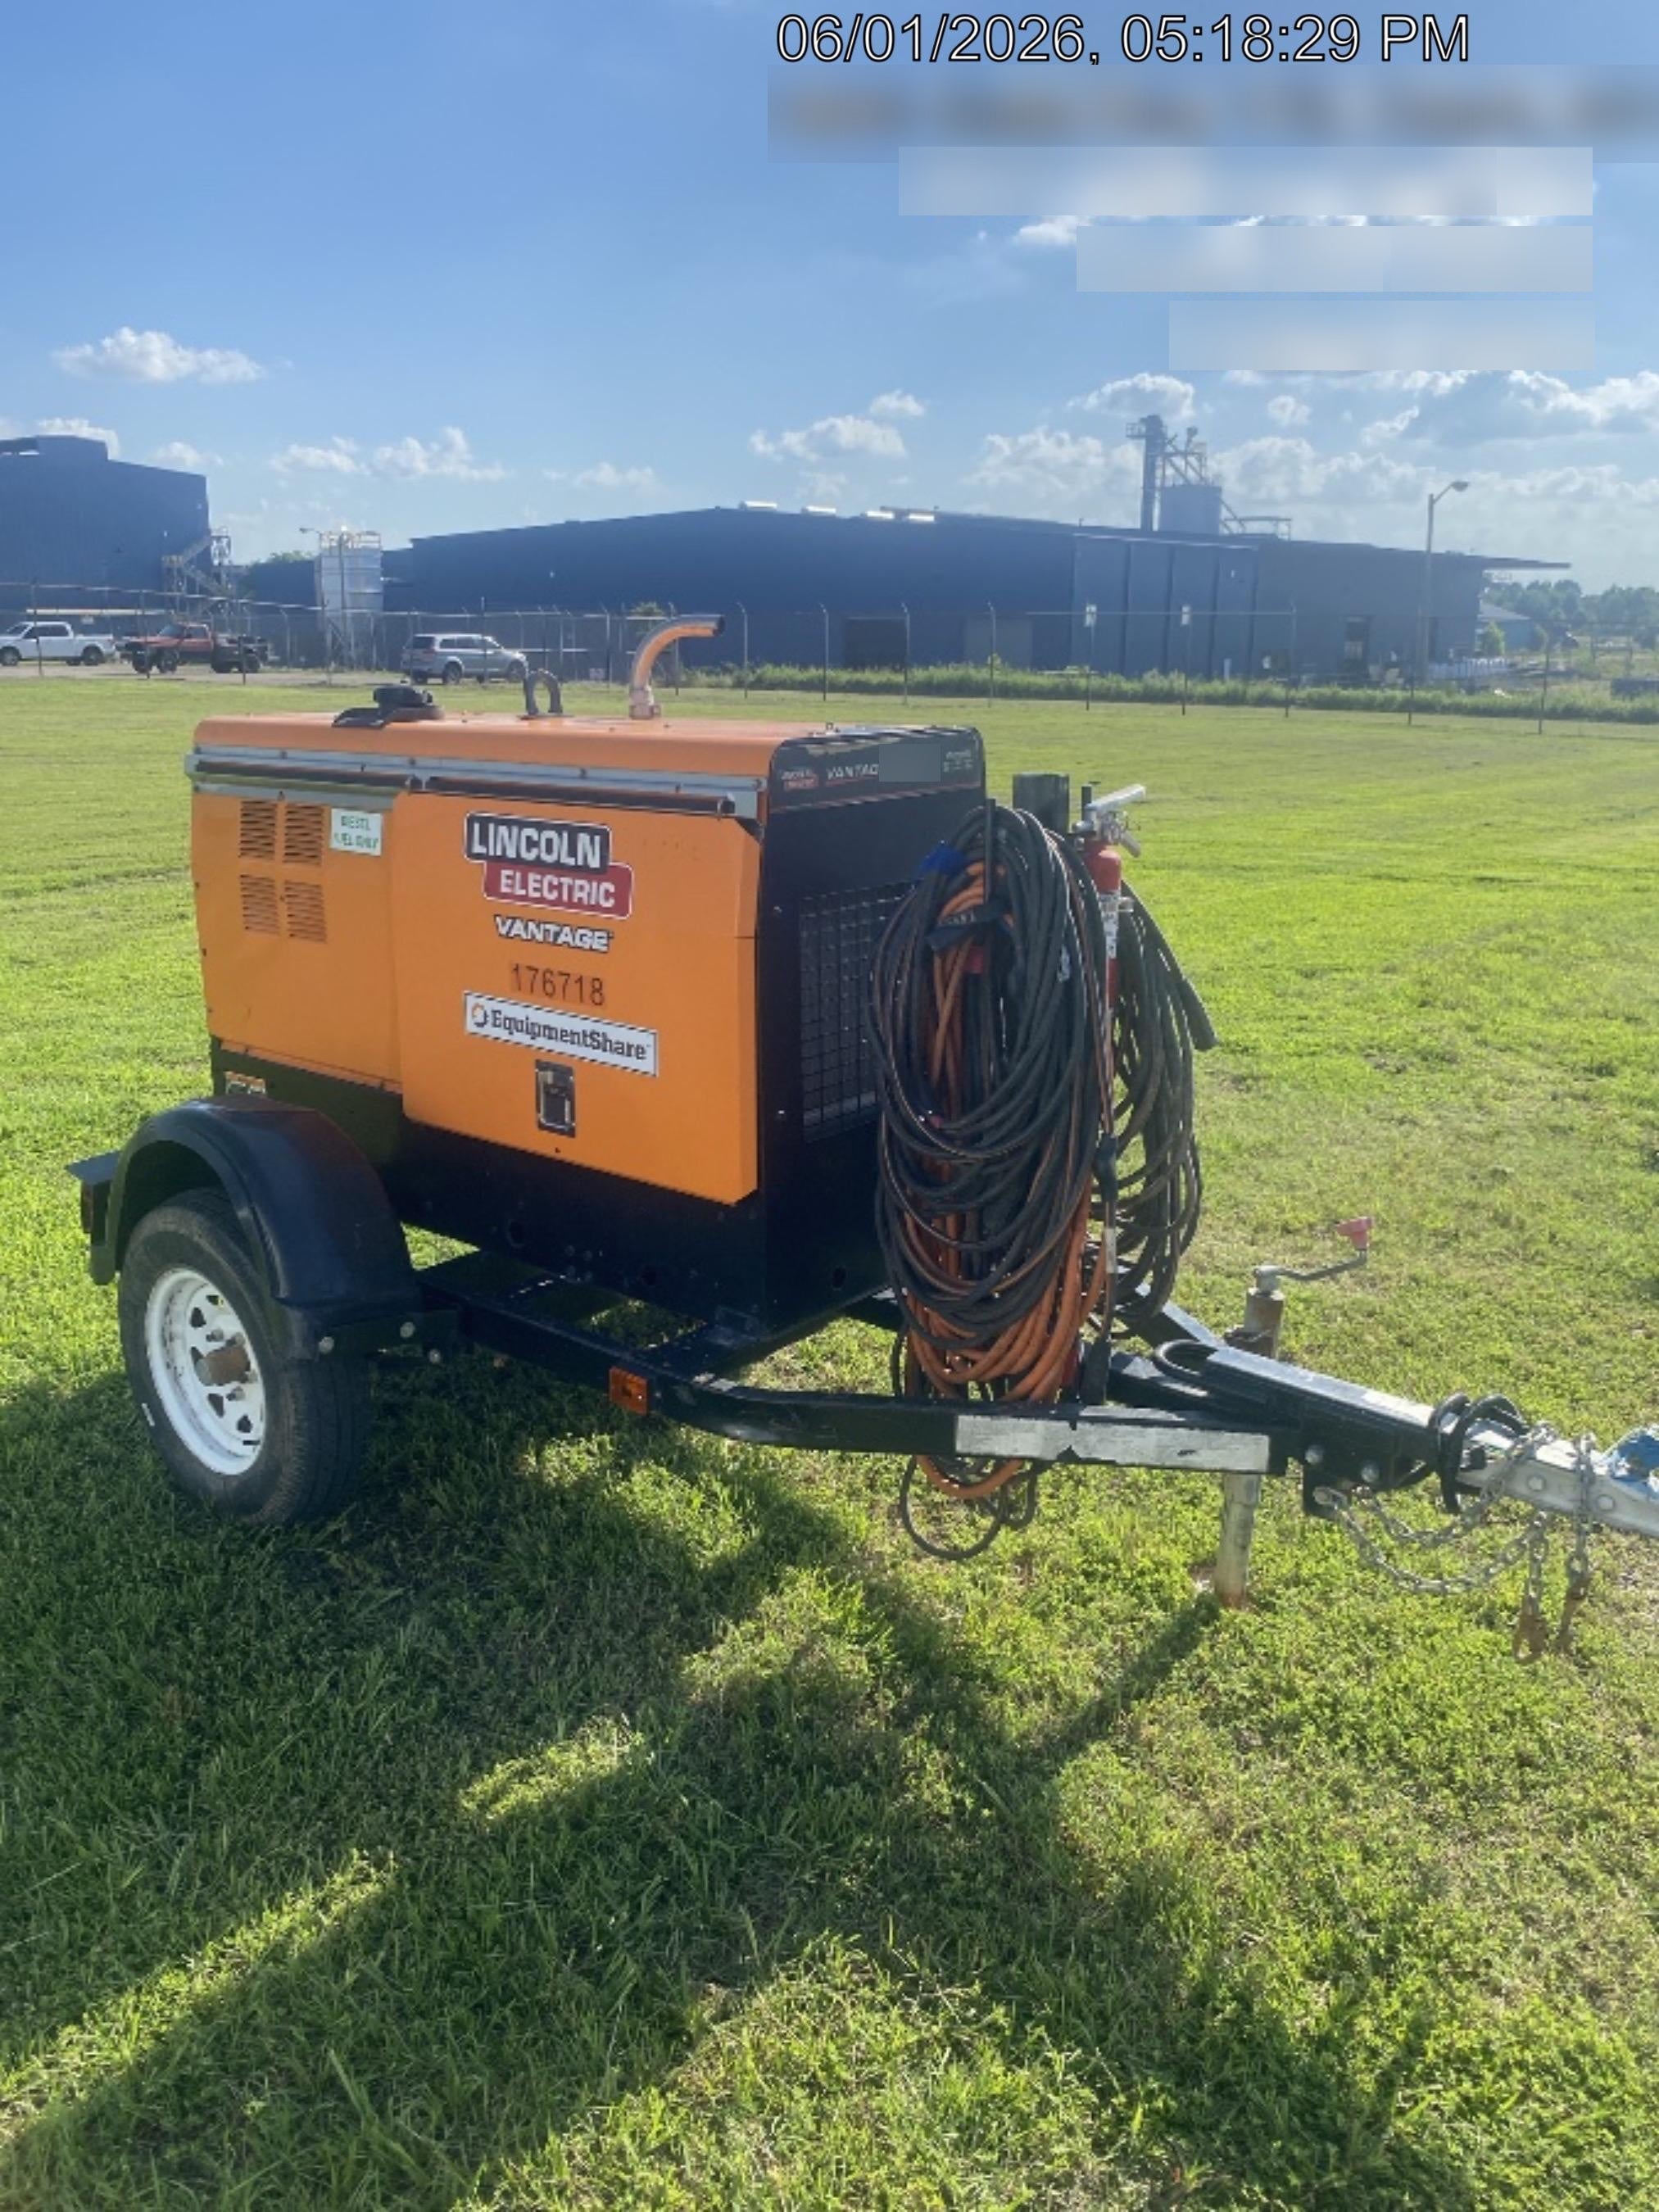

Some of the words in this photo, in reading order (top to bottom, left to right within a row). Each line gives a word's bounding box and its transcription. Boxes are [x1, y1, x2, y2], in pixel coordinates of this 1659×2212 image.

[826, 763, 879, 780] VANTAG
[472, 823, 601, 868] LINCOLN
[500, 870, 615, 908] ELECTRIC
[495, 915, 610, 953] VANTAGE
[512, 963, 605, 1006] 176718
[492, 1009, 647, 1060] EquipmentShare
